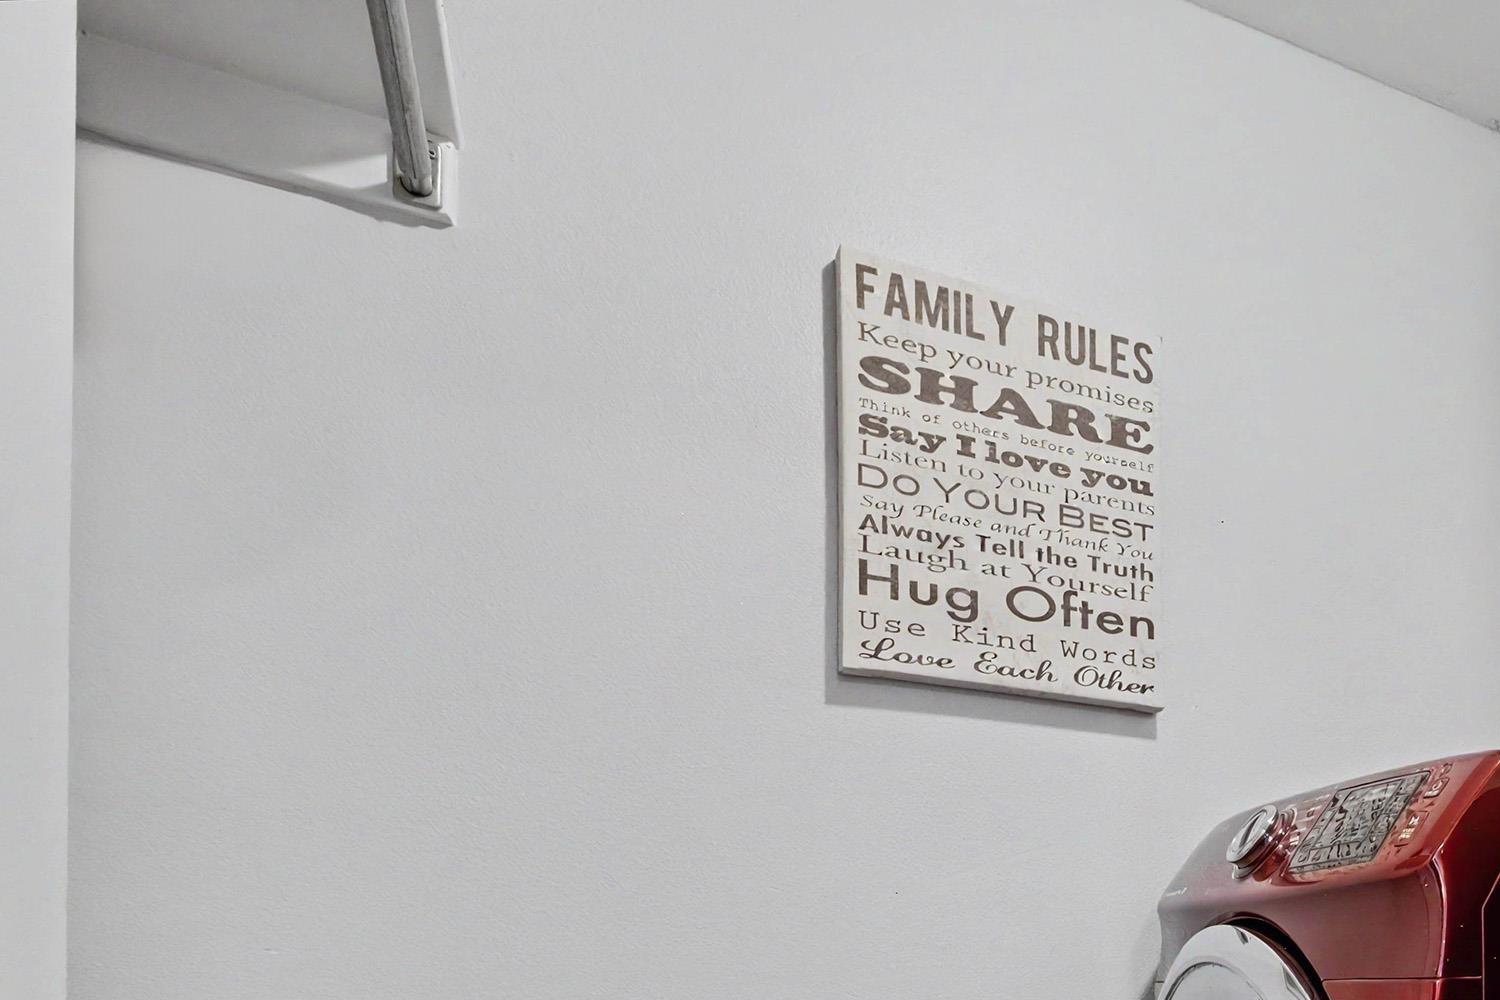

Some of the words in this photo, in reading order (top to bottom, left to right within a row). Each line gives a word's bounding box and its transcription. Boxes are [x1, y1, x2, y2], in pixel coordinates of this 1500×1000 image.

[855, 263, 1015, 346] FAMILY
[1038, 314, 1154, 384] RULES
[858, 321, 936, 363] Keep
[947, 349, 1016, 378] your
[1026, 370, 1154, 413] promises
[858, 355, 1154, 455] SHARE
[858, 413, 946, 453] Say
[956, 433, 976, 458] I
[985, 440, 1071, 478] love
[1080, 467, 1154, 496] you
[859, 397, 911, 418] Think
[922, 413, 941, 424] of
[952, 419, 1009, 440] others
[1020, 434, 1075, 455] before
[1085, 451, 1154, 472] yourself
[857, 462, 920, 496] DO
[933, 477, 1046, 523] YOUR
[1059, 504, 1154, 542] BEST
[859, 440, 947, 472] Listen
[959, 460, 984, 480] to
[993, 472, 1054, 494] your
[1064, 488, 1156, 516] parents
[858, 514, 965, 549] Always
[976, 535, 1024, 559] Tell
[1036, 546, 1078, 568] the
[1087, 555, 1154, 582] Truth
[861, 495, 904, 518] Say
[912, 504, 982, 529] Please
[990, 521, 1036, 538] and
[1039, 528, 1109, 552] Thank
[1117, 542, 1154, 562] You
[858, 535, 969, 573] Laugh
[981, 560, 1011, 578] at
[1025, 564, 1154, 602] Yourself
[858, 559, 979, 623] Hug
[1006, 585, 1155, 640] Often
[858, 610, 926, 637] Use
[952, 625, 1037, 653] Kind
[1060, 640, 1156, 669] Words
[859, 638, 956, 668] Love
[974, 652, 1058, 682] Each
[1074, 665, 1155, 694] Other
